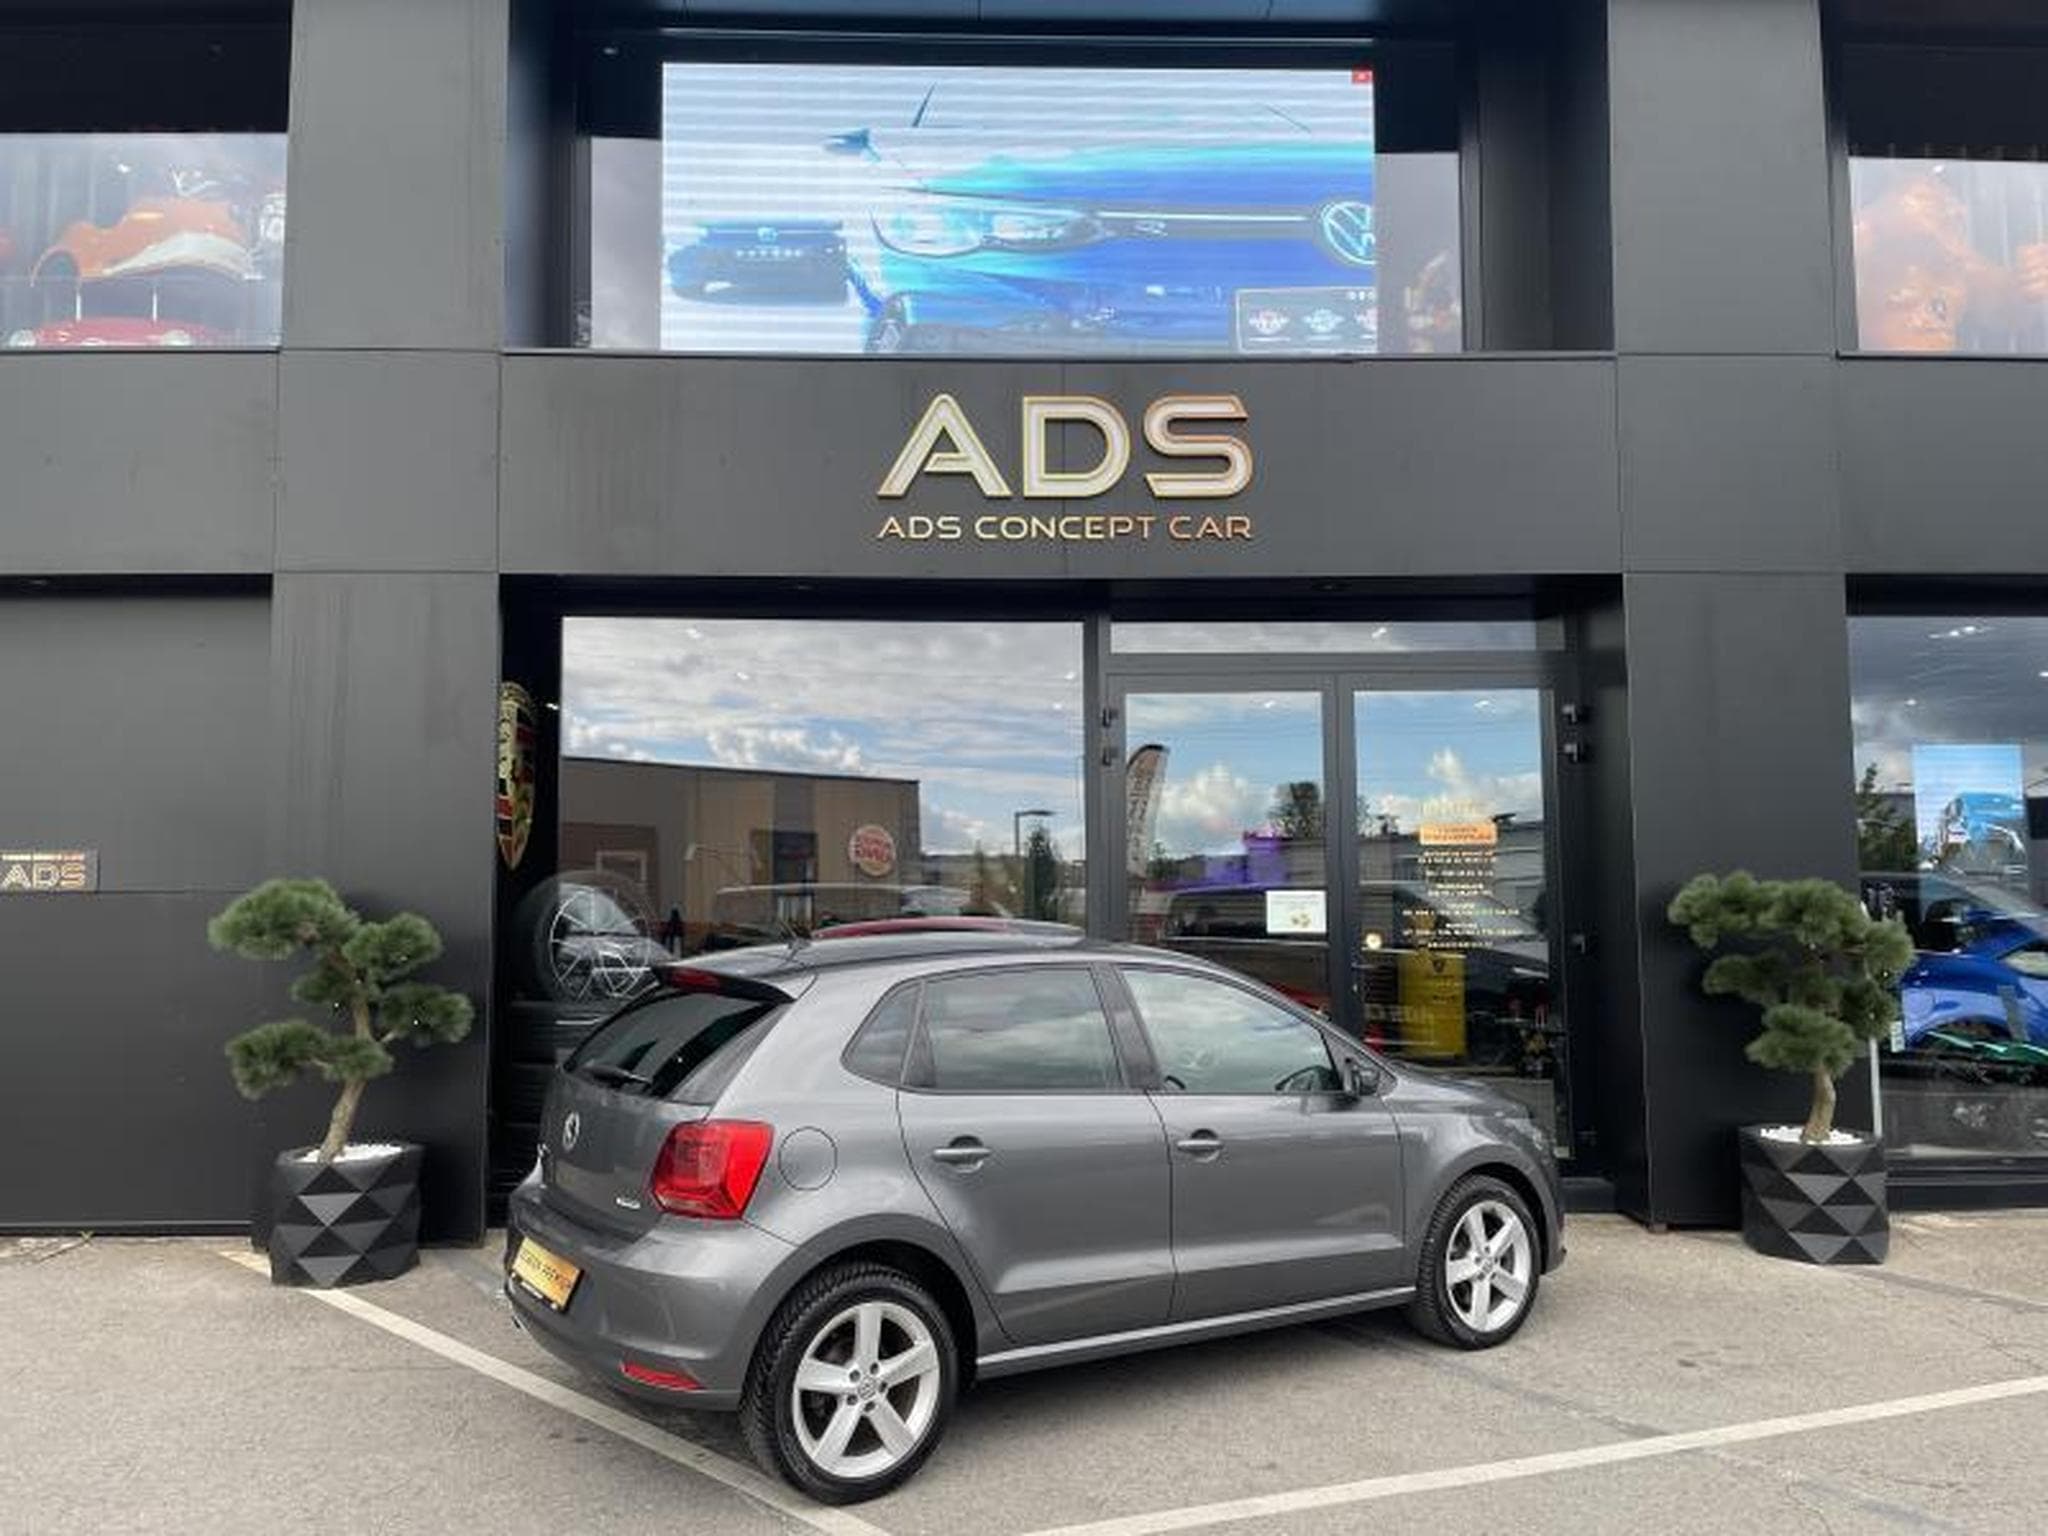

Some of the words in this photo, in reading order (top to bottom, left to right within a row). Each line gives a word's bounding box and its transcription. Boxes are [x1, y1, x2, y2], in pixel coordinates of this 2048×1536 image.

[876, 393, 1254, 499] ADS
[876, 515, 963, 540] ADS
[973, 515, 1156, 540] CONCEPT
[1168, 515, 1253, 540] CAR
[1, 862, 87, 890] ADS
